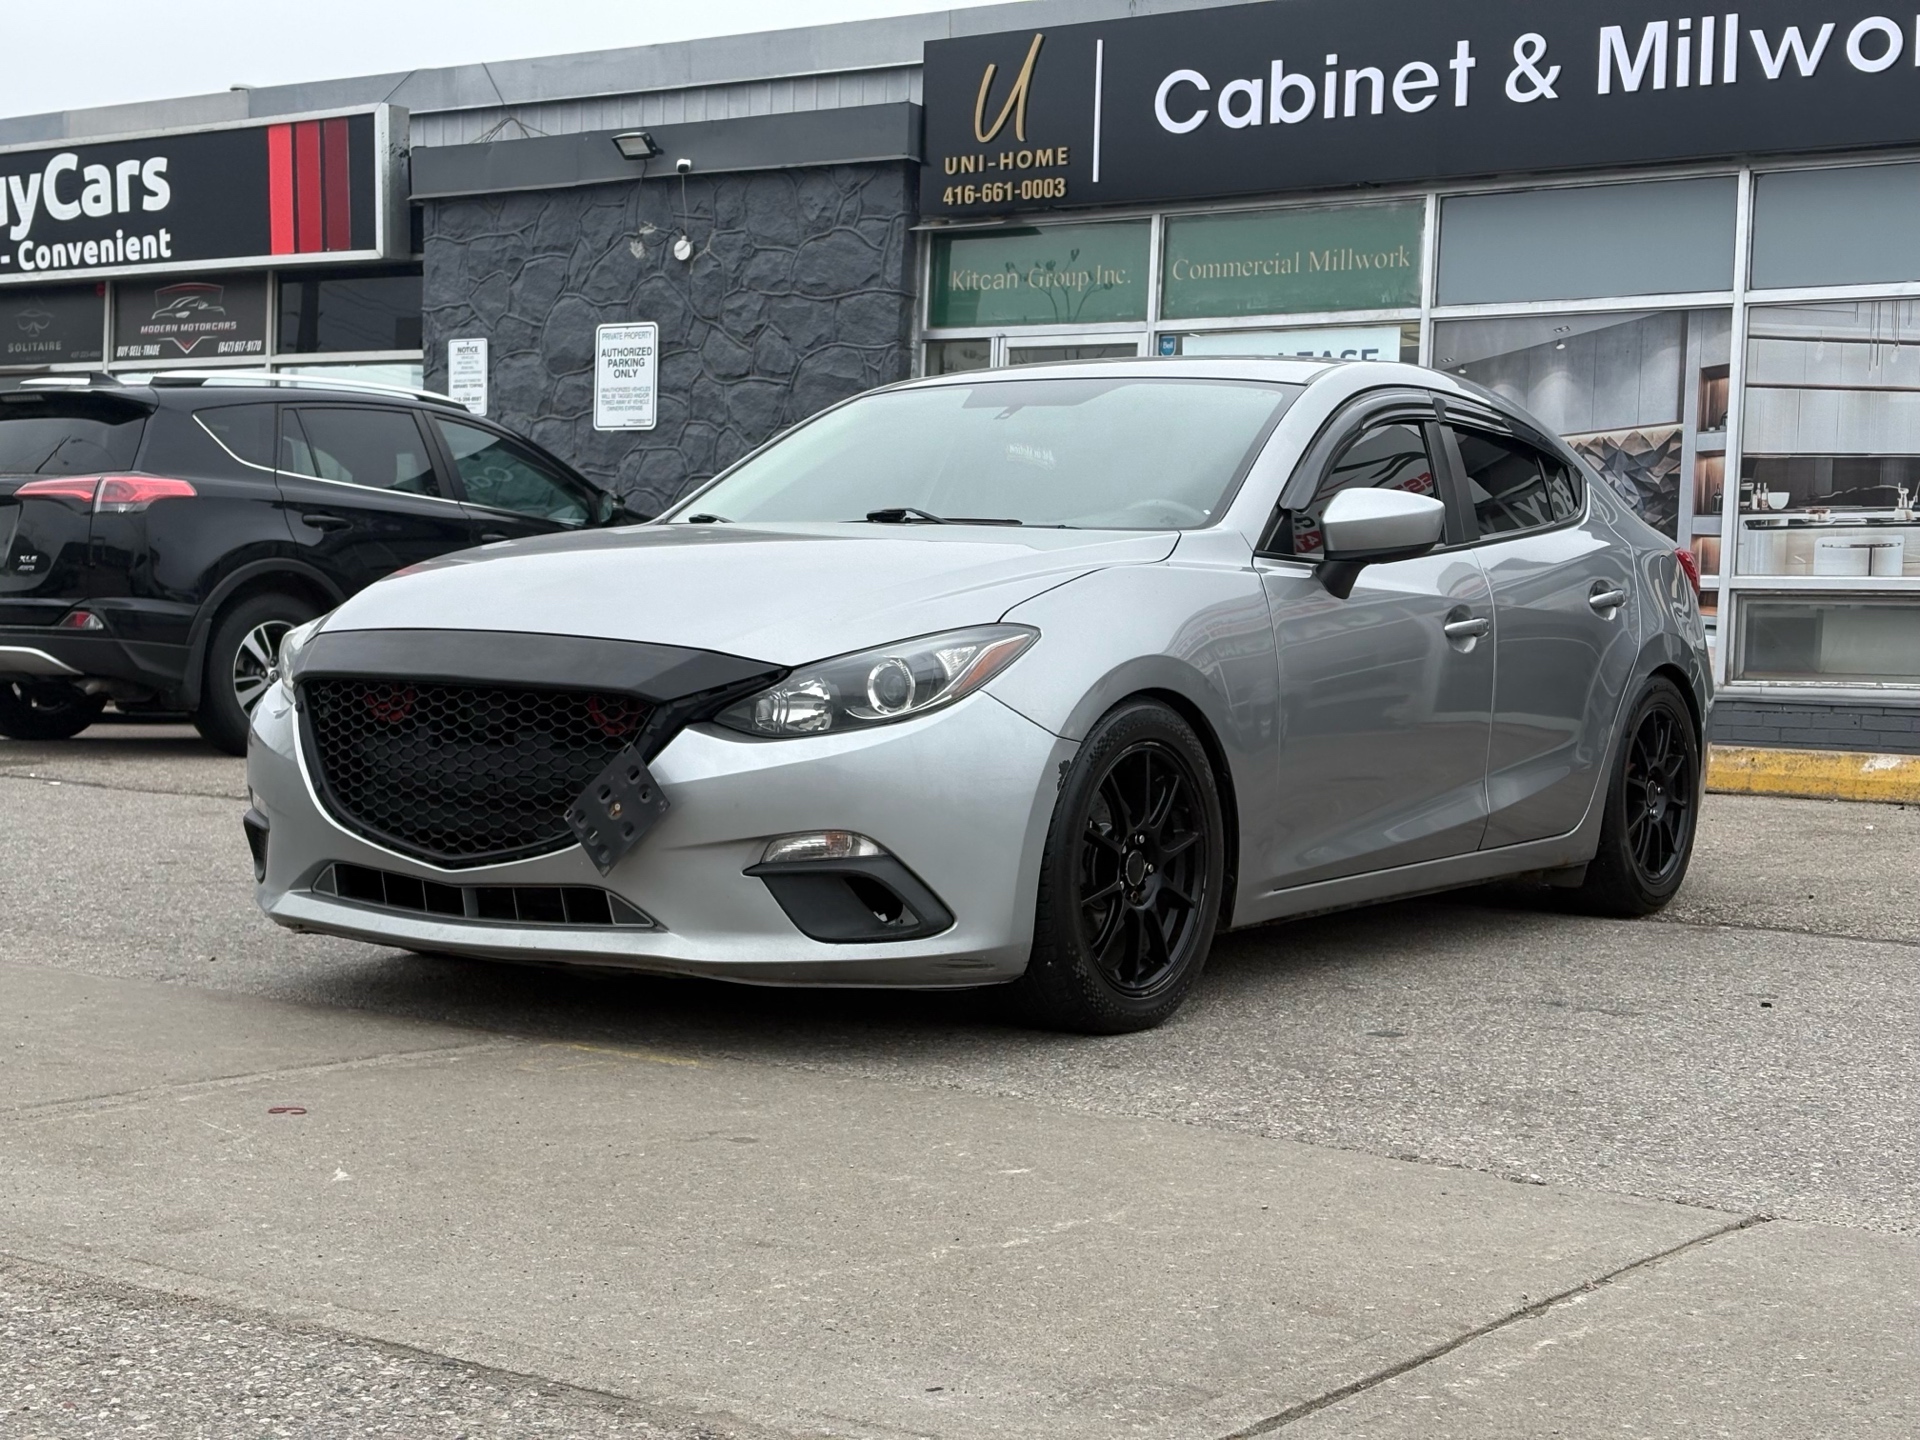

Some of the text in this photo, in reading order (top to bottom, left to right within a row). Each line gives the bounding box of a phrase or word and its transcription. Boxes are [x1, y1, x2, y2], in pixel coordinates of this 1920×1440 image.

[1154, 13, 1920, 134] Cabinet & Millwo
[945, 147, 1068, 175] UNI-HOME
[0, 153, 171, 241] yCars
[943, 177, 1066, 206] 416-661-0003
[17, 227, 172, 271] Convenient
[1172, 245, 1411, 281] Commercial Millwork
[952, 265, 1131, 292] Kitcan Group Inc.
[140, 321, 237, 334] MODERN MOTORCARS
[7, 340, 62, 353] SOLITAIRE
[457, 346, 479, 354] NOTICE
[601, 346, 653, 358] AUTHORIZED
[1162, 341, 1174, 349] Bell
[607, 357, 645, 368] PARKING
[613, 369, 639, 378] ONLY
